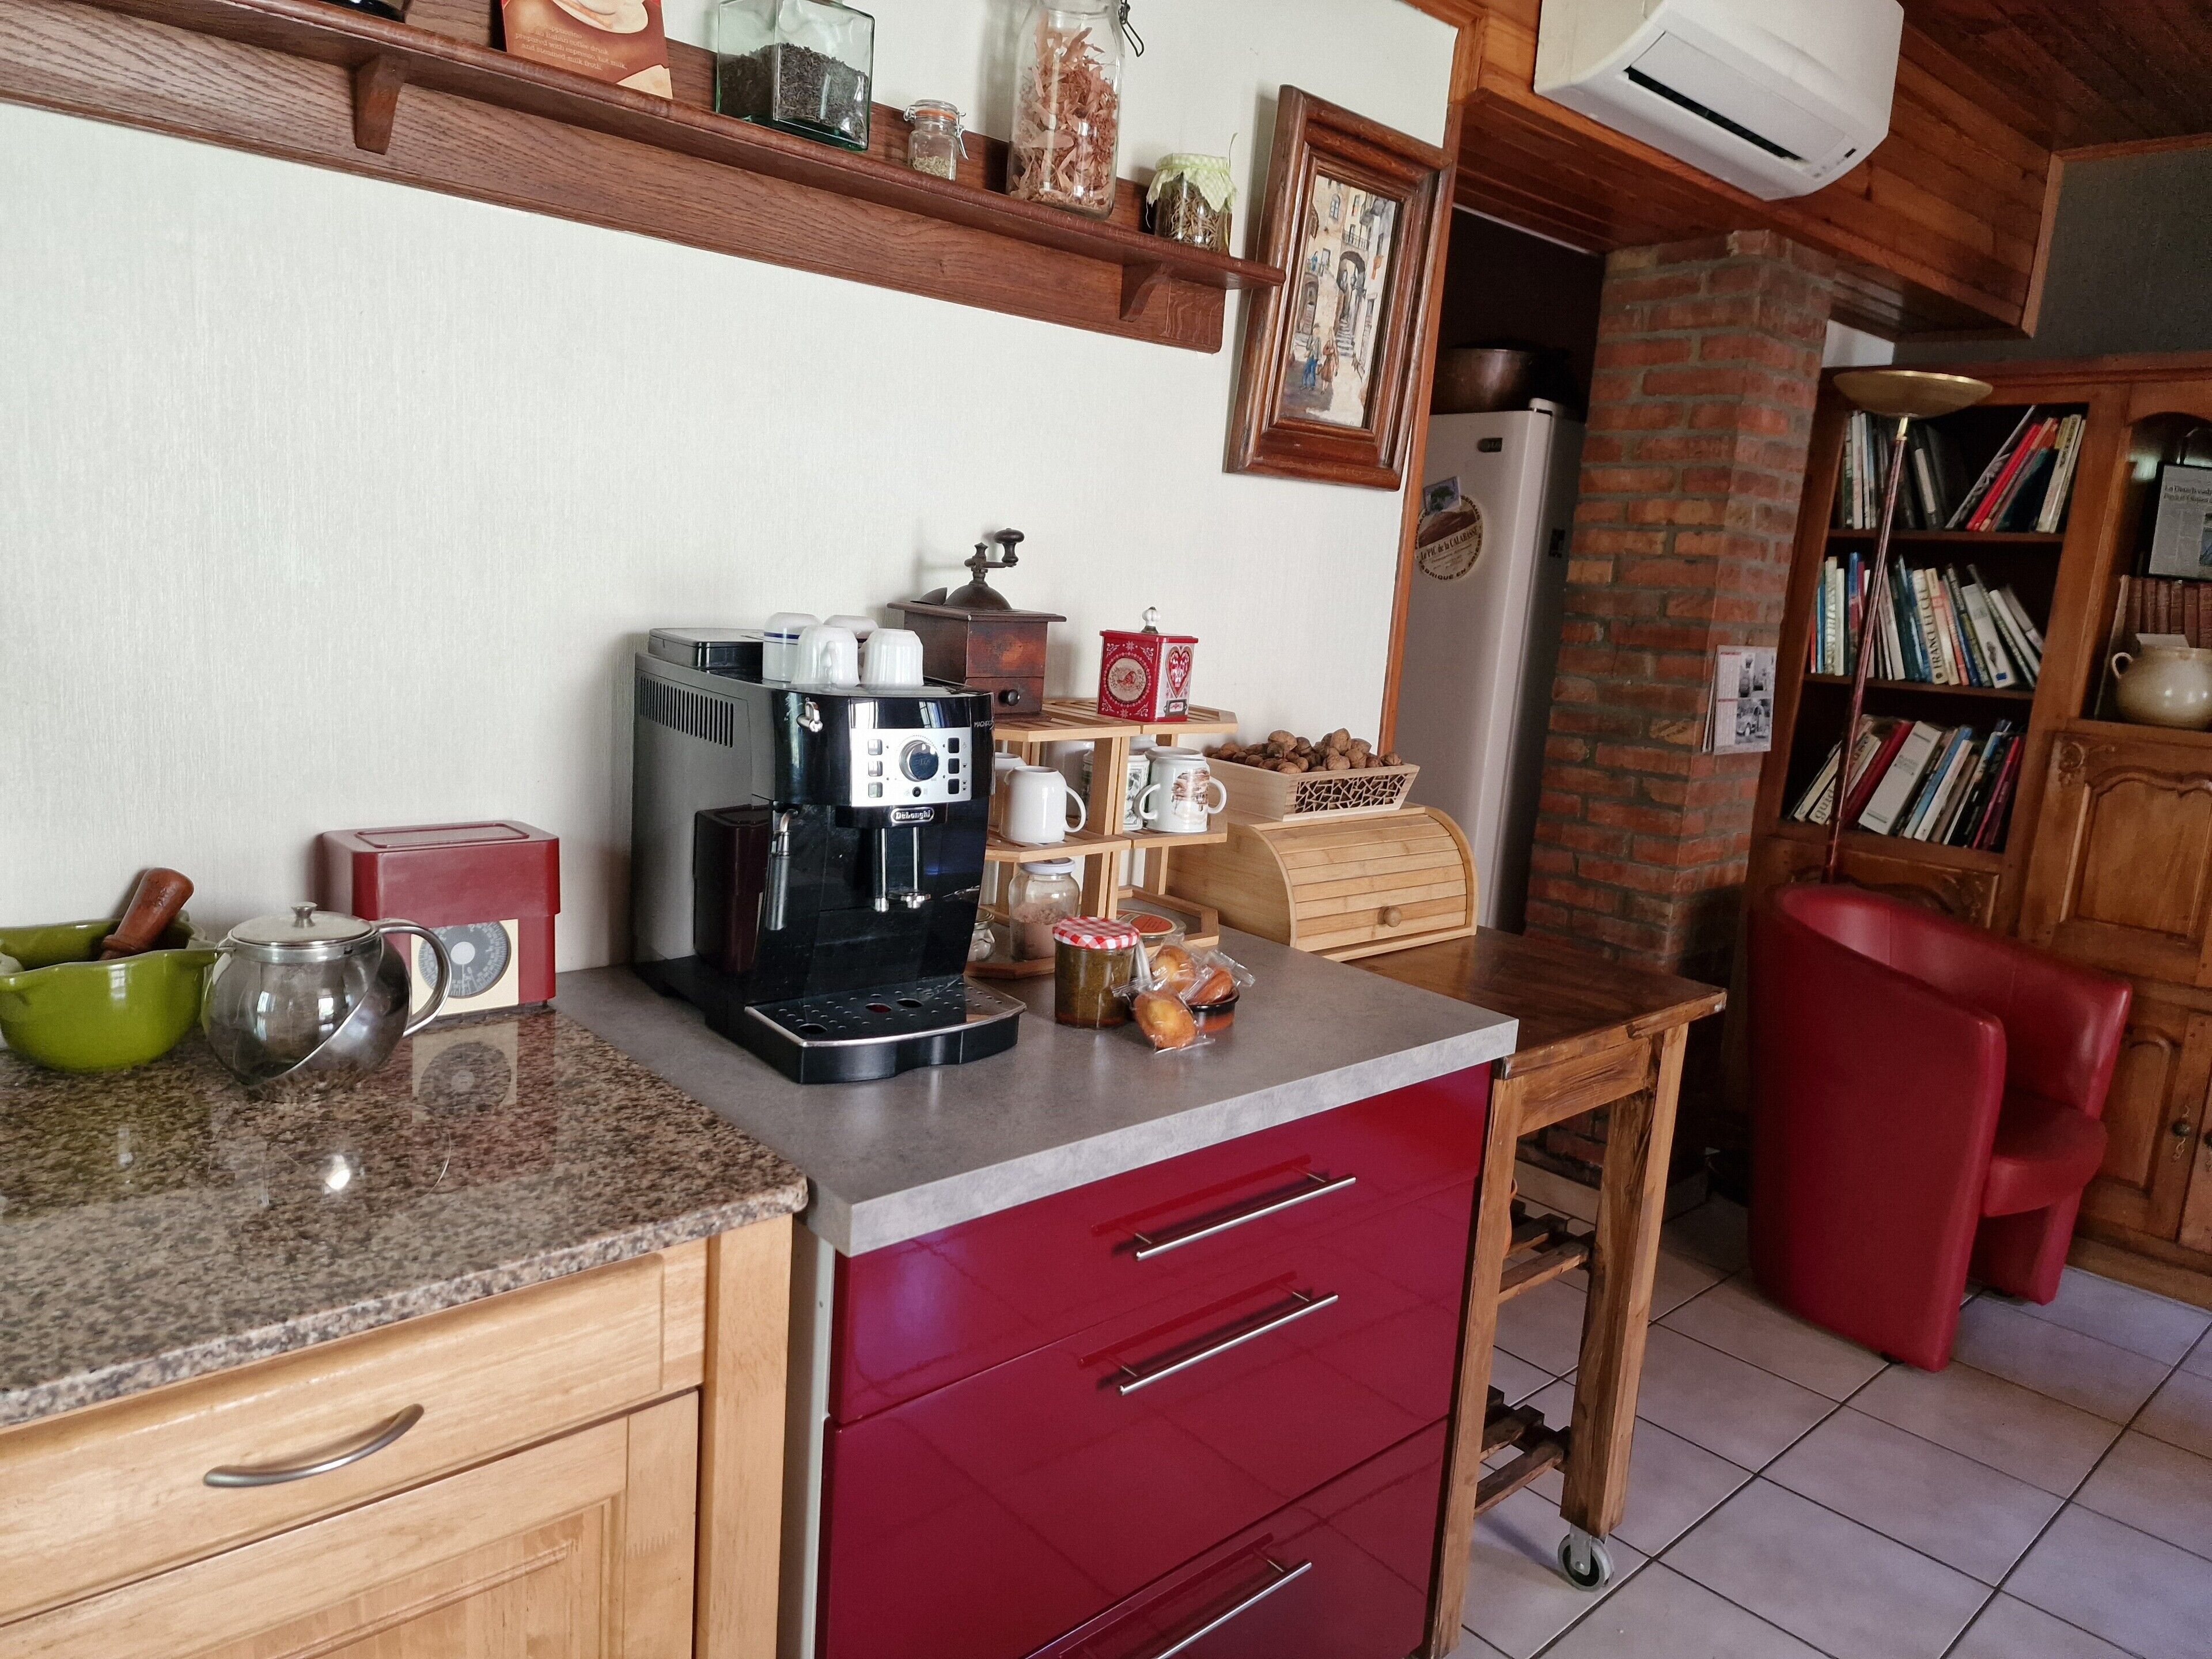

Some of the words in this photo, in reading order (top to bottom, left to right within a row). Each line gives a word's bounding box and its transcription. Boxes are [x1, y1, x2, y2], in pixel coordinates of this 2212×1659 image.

[516, 32, 548, 46] prepared
[548, 41, 565, 51] with
[521, 43, 536, 51] and
[536, 47, 566, 60] steamed
[566, 56, 584, 65] milk
[1438, 543, 1444, 552] de
[1815, 788, 1834, 820] guid
